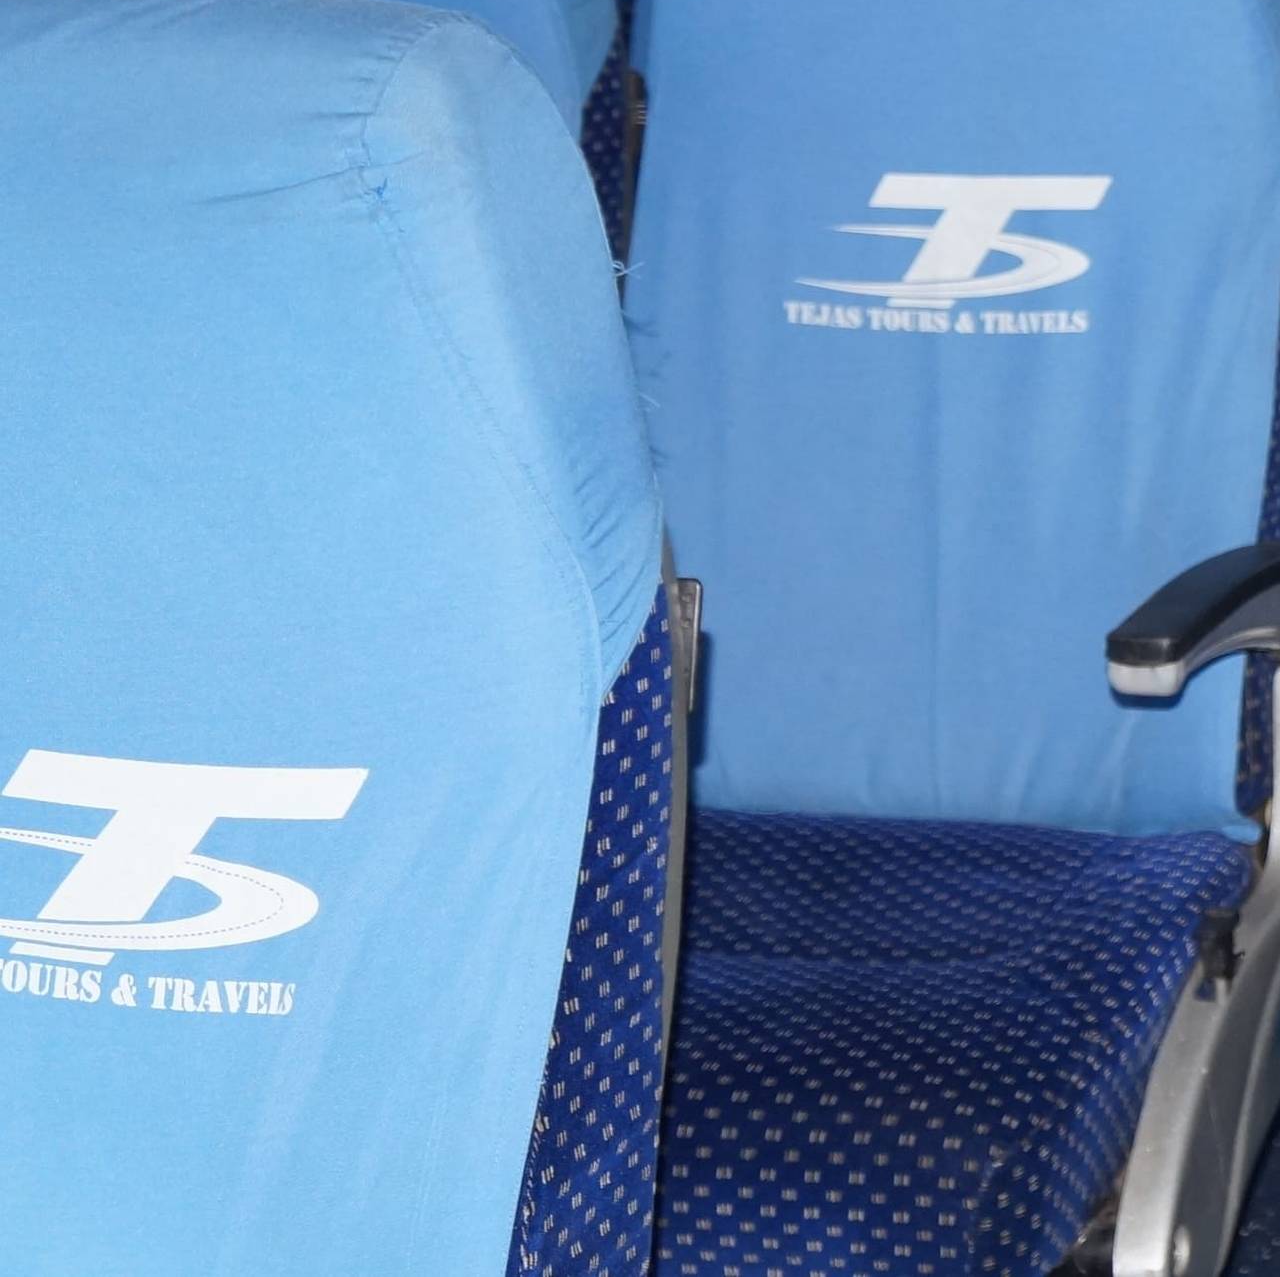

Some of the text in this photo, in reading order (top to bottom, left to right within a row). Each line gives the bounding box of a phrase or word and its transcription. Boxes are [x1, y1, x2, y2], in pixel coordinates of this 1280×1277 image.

[783, 301, 1089, 335] TEJAS TOURS & TRAVELS
[111, 973, 137, 1007] &
[148, 976, 296, 1015] TRAVELS
